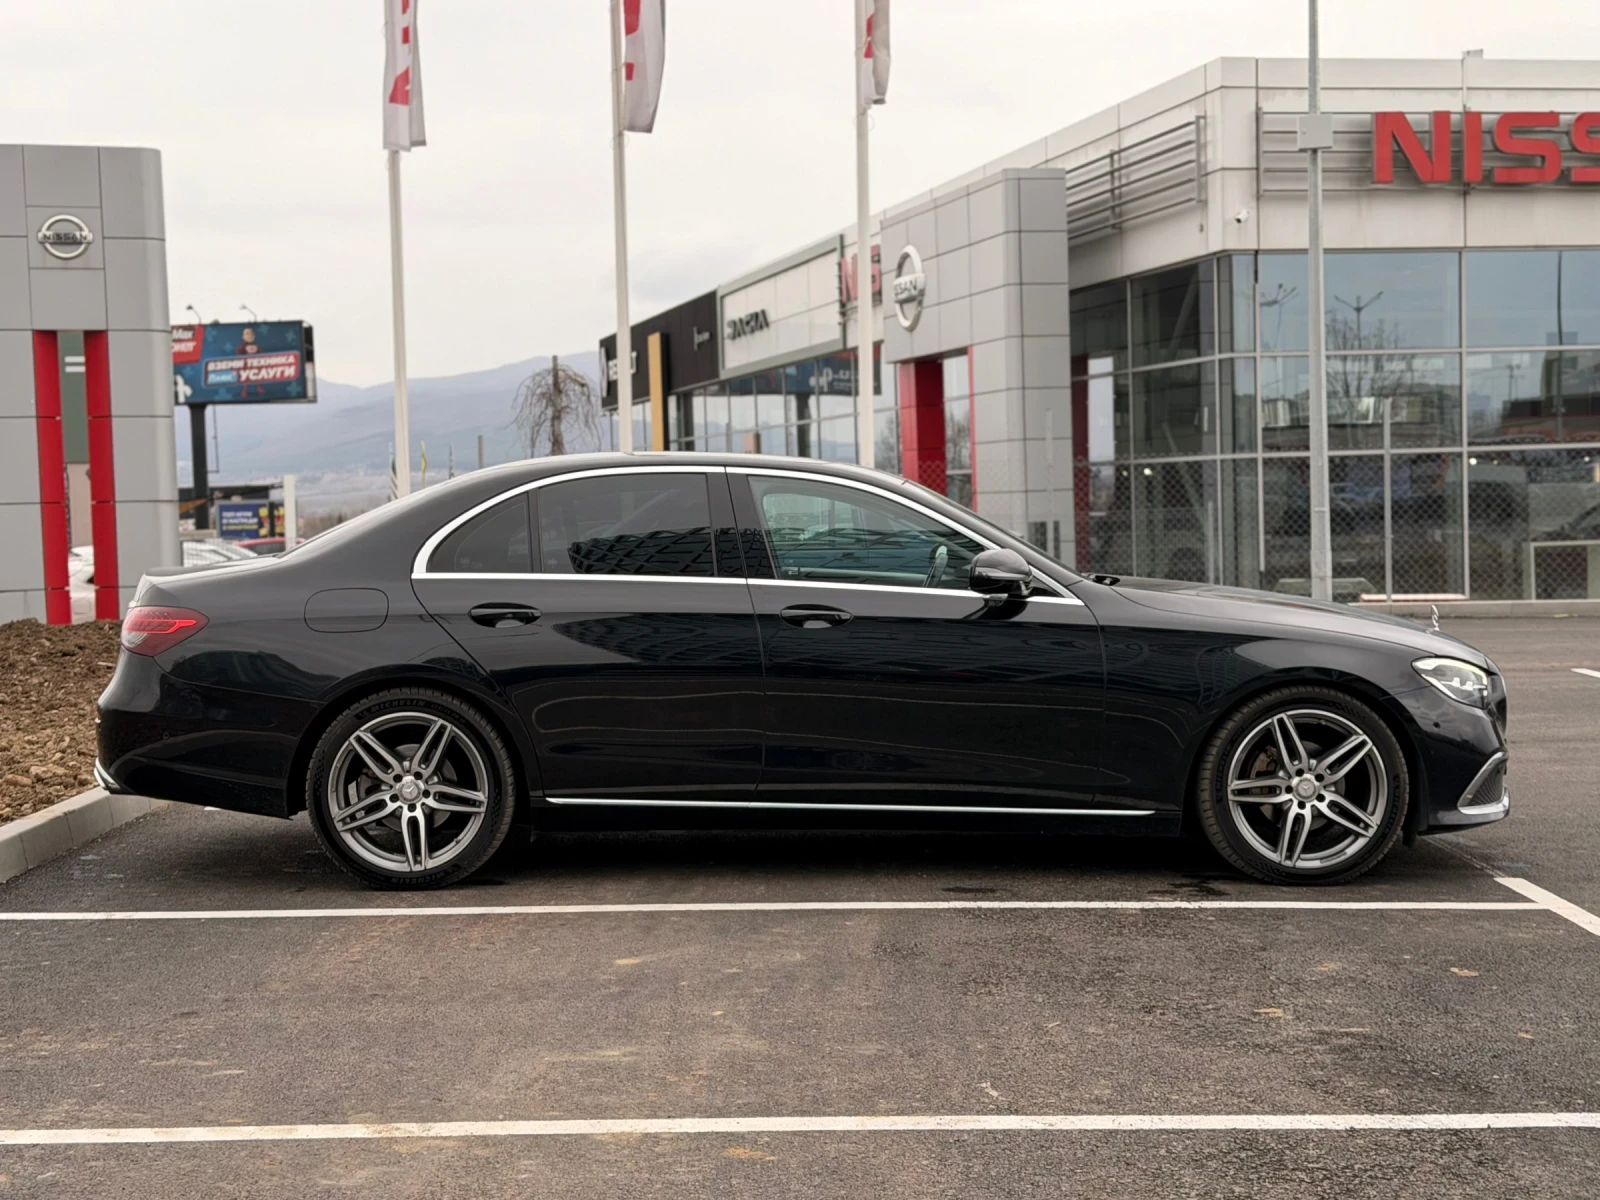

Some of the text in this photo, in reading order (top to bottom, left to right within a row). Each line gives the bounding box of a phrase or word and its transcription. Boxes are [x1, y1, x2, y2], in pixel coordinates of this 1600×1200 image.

[42, 231, 88, 242] NISSAN
[246, 355, 295, 368] ТЕХНИКА
[239, 366, 295, 382] УСЛУГИ
